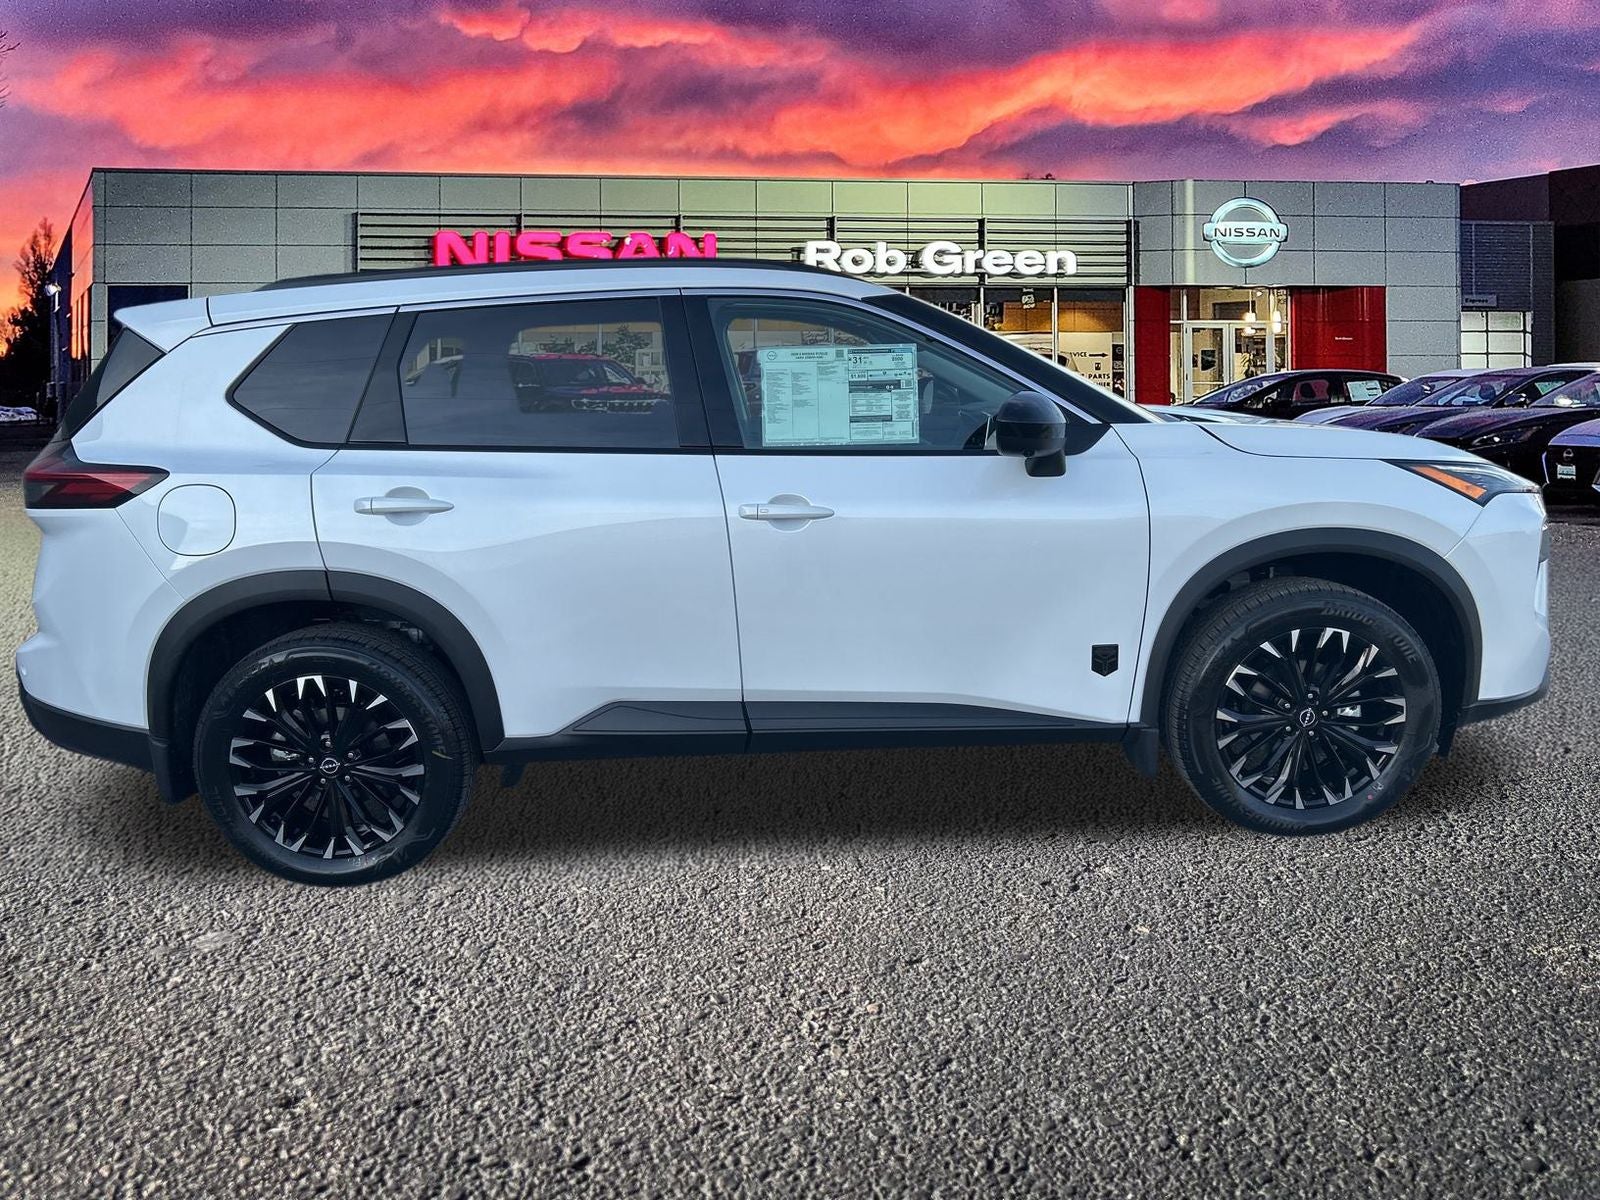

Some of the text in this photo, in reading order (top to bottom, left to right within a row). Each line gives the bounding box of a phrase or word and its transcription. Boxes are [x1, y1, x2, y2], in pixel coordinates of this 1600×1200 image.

[1214, 227, 1281, 238] NISSAN
[433, 231, 718, 266] NISSAN
[804, 240, 1078, 276] Rob Green
[852, 356, 862, 364] 31
